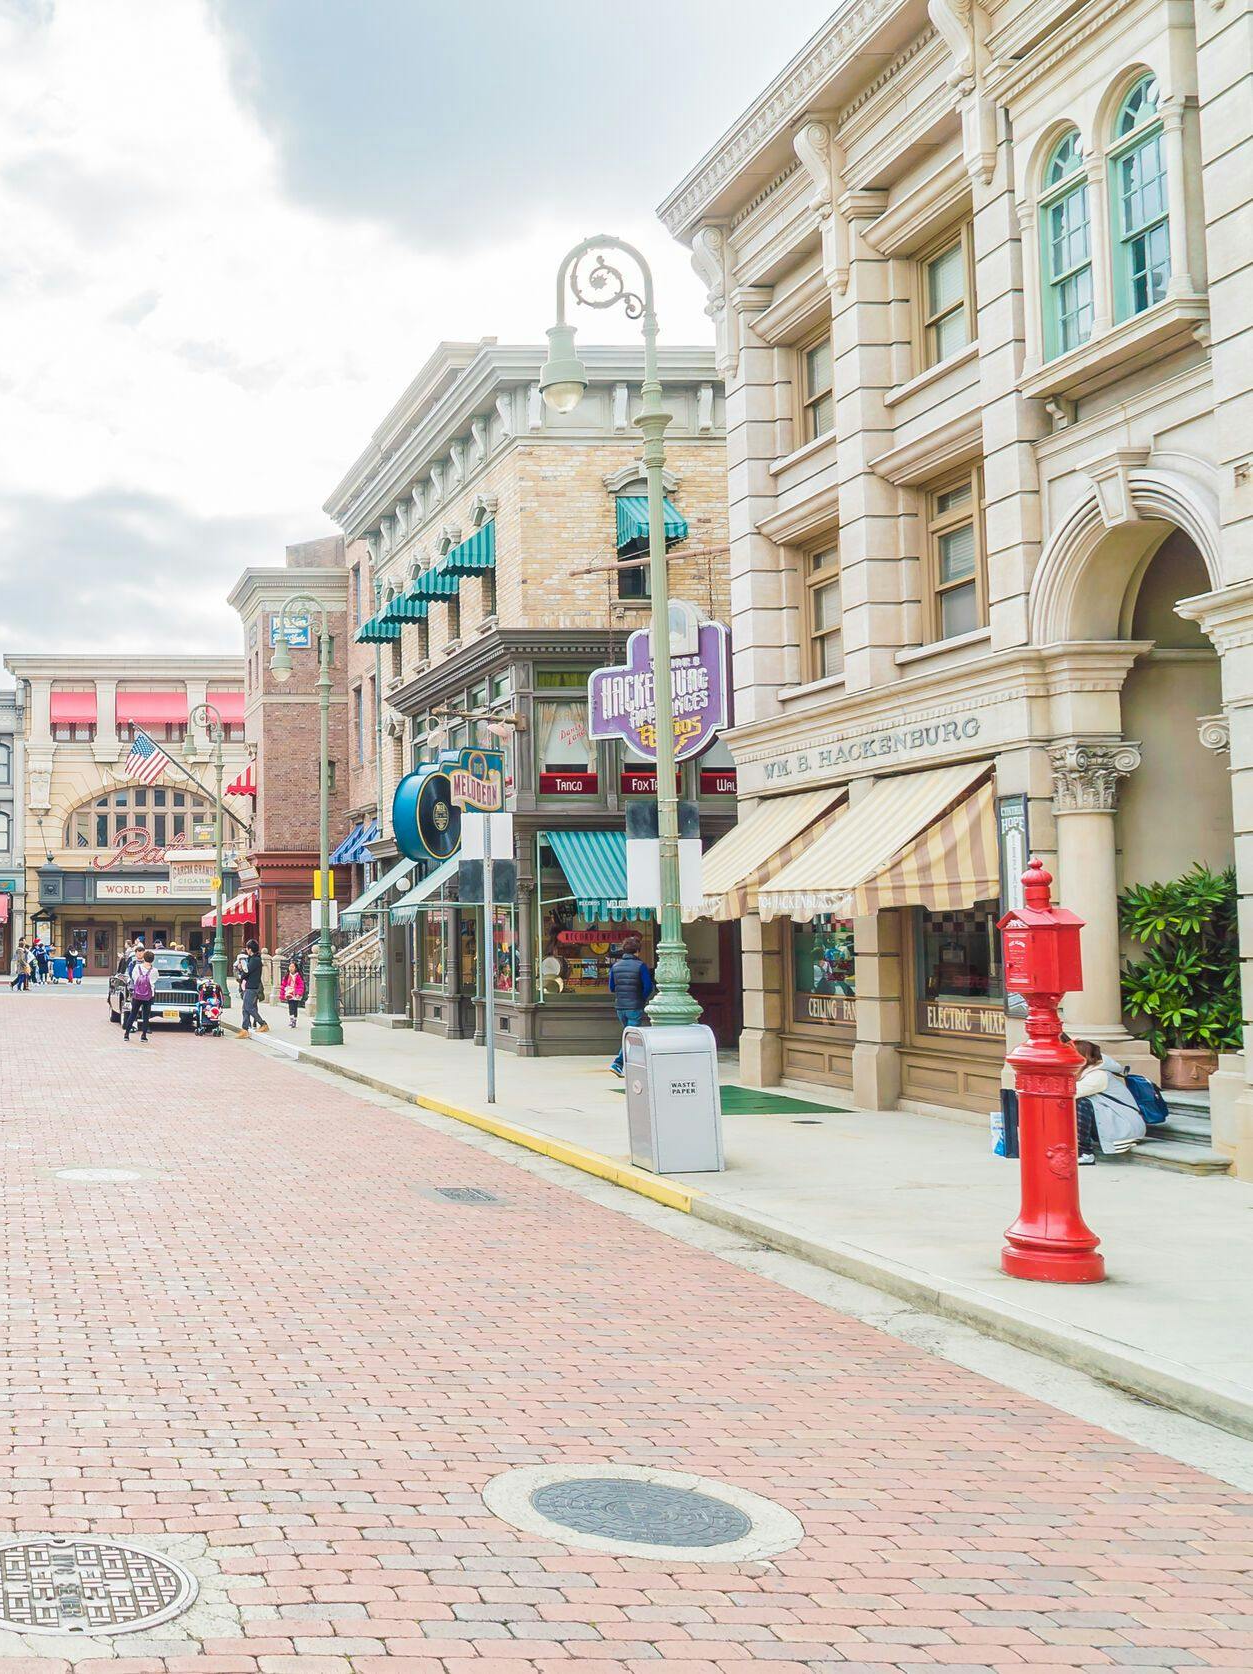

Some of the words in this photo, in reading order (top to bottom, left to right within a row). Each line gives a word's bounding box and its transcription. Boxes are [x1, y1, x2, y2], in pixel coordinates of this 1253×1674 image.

[763, 759, 792, 780] WM.
[797, 755, 812, 773] B.
[819, 718, 981, 769] HACKENBURG
[453, 774, 498, 807] MELODEON
[555, 779, 583, 791] TANGO
[717, 779, 737, 791] WAL
[105, 885, 145, 894] WORLD
[808, 998, 837, 1020] CEILING
[843, 999, 857, 1020] FAN
[927, 1006, 973, 1031] ELECTRIC
[980, 1010, 1006, 1035] MIXE
